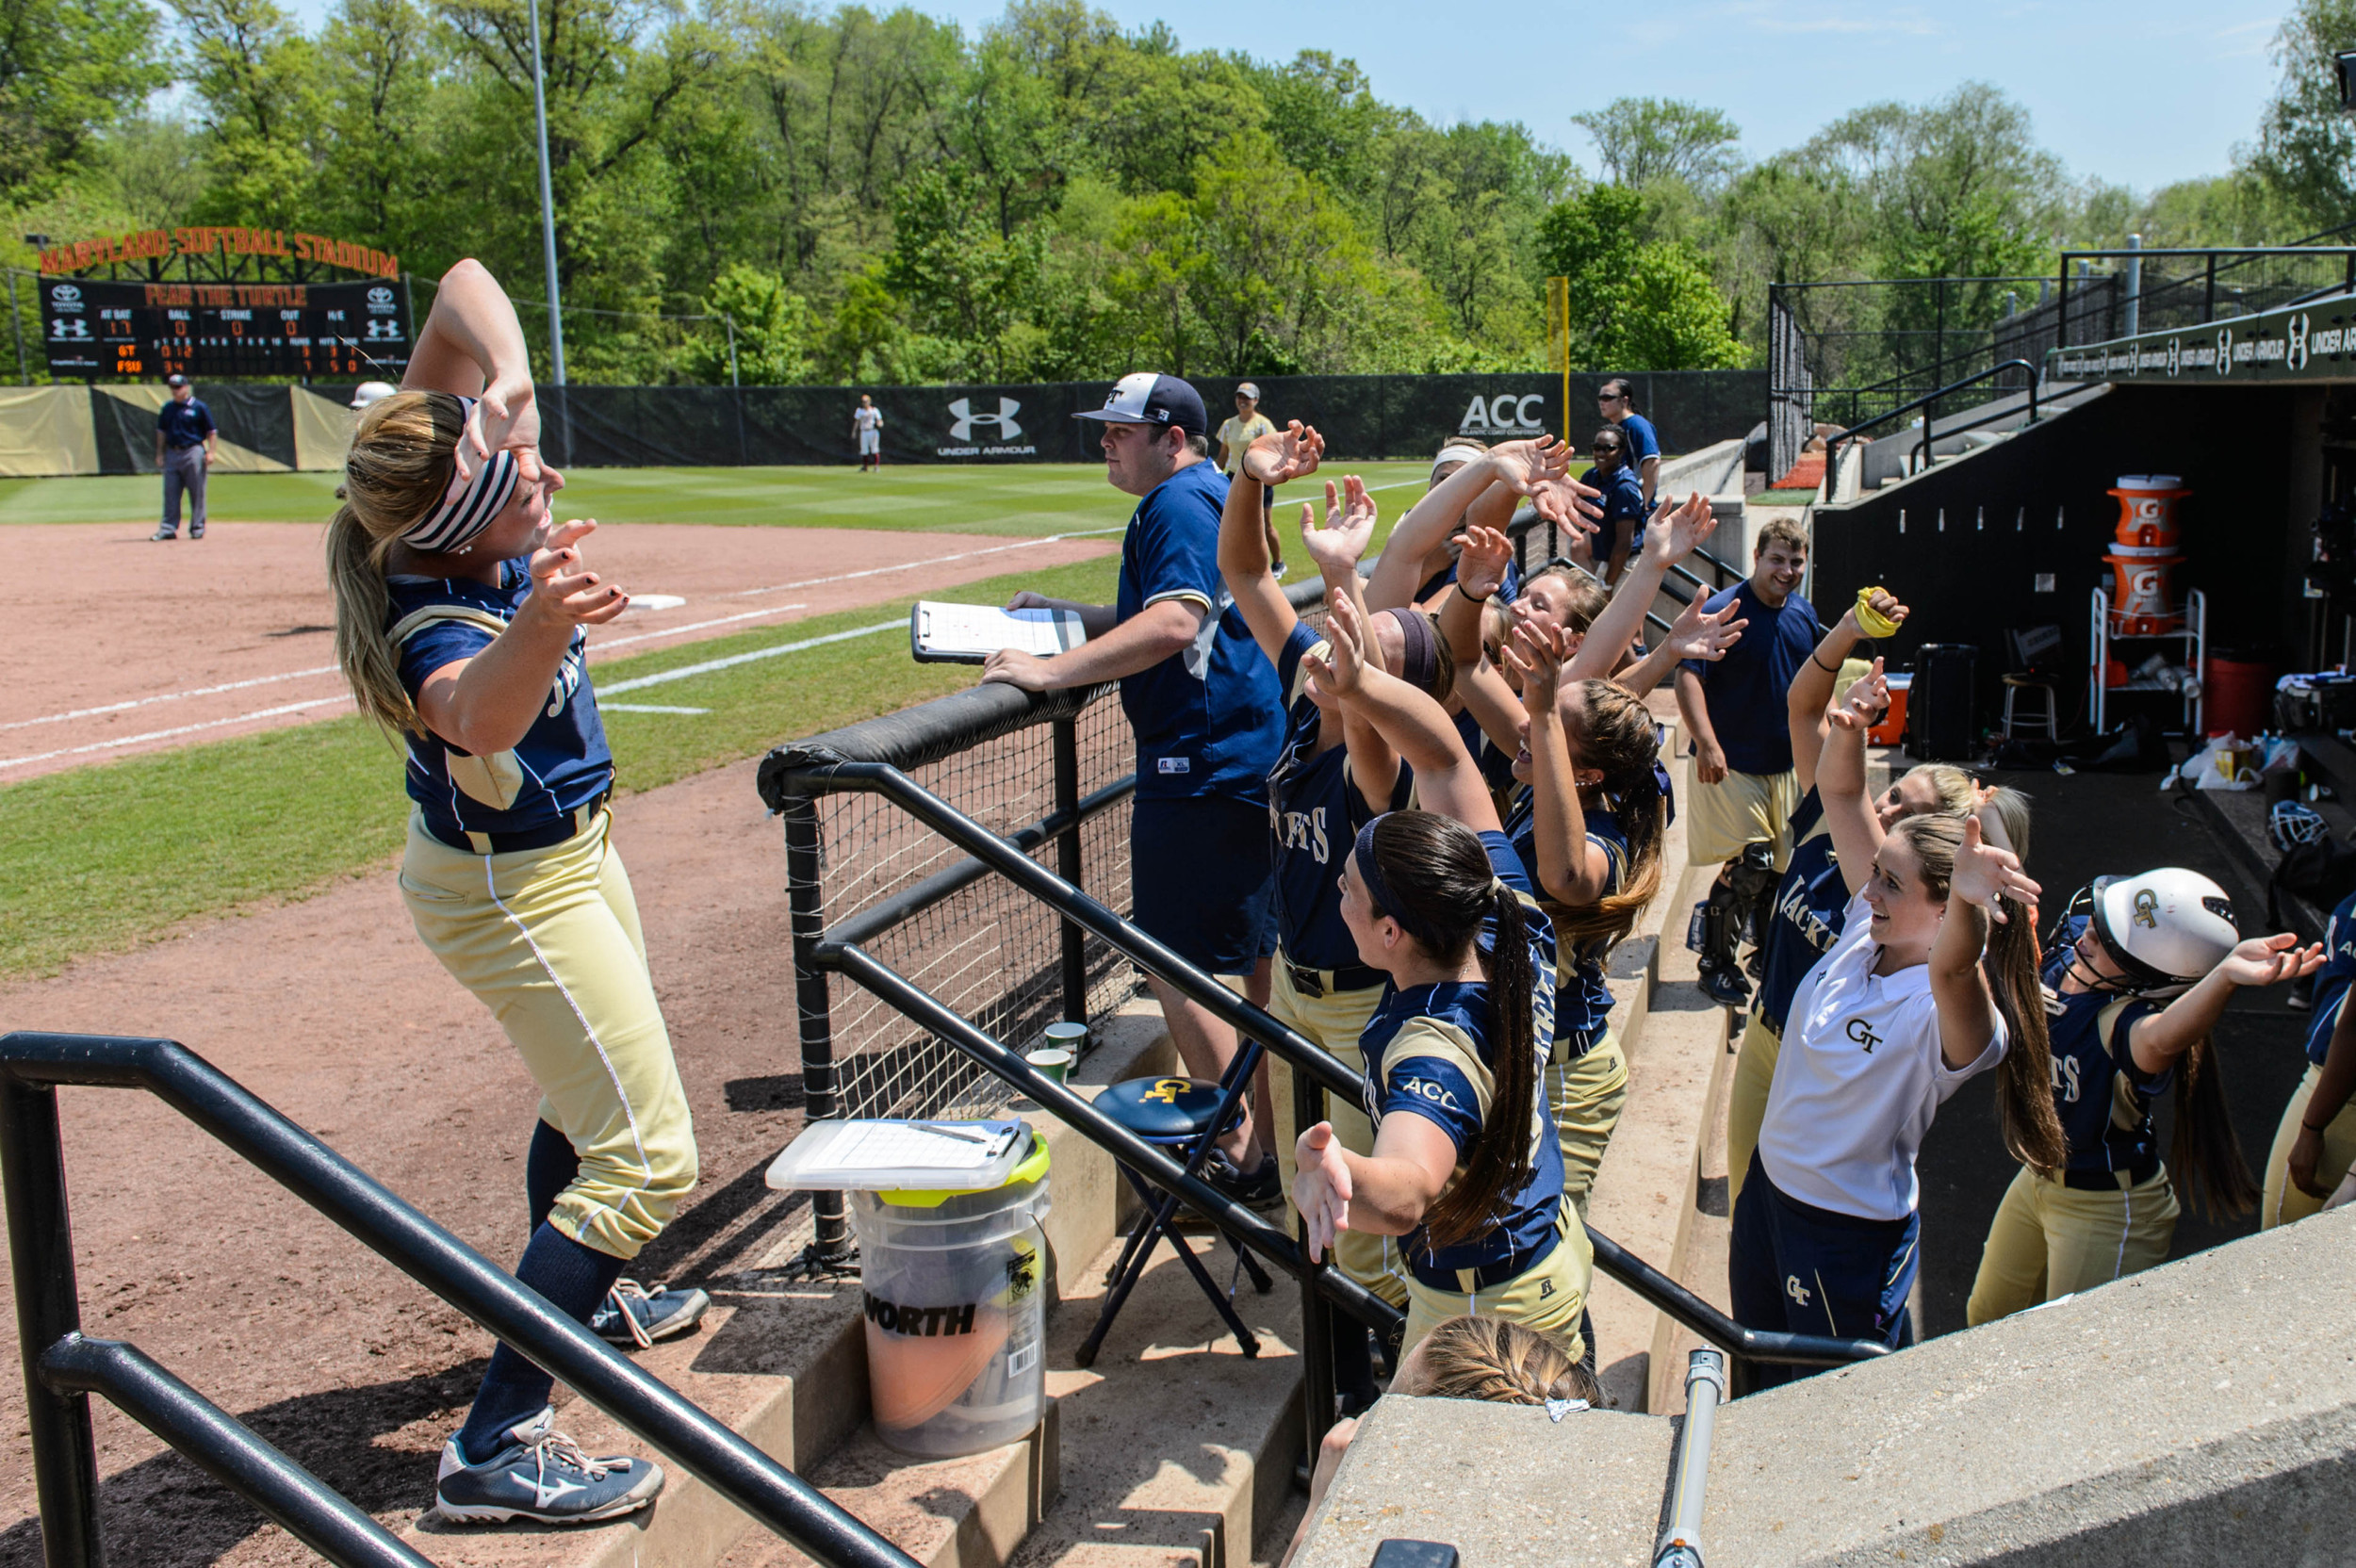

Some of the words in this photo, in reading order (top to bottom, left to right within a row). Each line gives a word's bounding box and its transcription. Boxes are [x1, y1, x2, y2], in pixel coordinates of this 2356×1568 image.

[39, 229, 171, 276] MARYLAND
[174, 225, 291, 255] SOFTBALL
[294, 233, 400, 282] STADIUM
[145, 284, 193, 306] FEAR
[194, 285, 235, 306] THE
[235, 285, 307, 307] TURTLE
[168, 309, 191, 319] BALL
[220, 309, 252, 320] STRIKE
[280, 309, 300, 320] OUT
[2311, 328, 2342, 355] UNDER
[117, 360, 142, 373] FSU
[1459, 393, 1545, 429] ACC
[937, 447, 980, 456] UNDER
[982, 446, 1036, 454] ARMOUR
[1845, 1018, 1884, 1054] GT
[1402, 1076, 1458, 1111] ACC
[1786, 1274, 1811, 1306] GT
